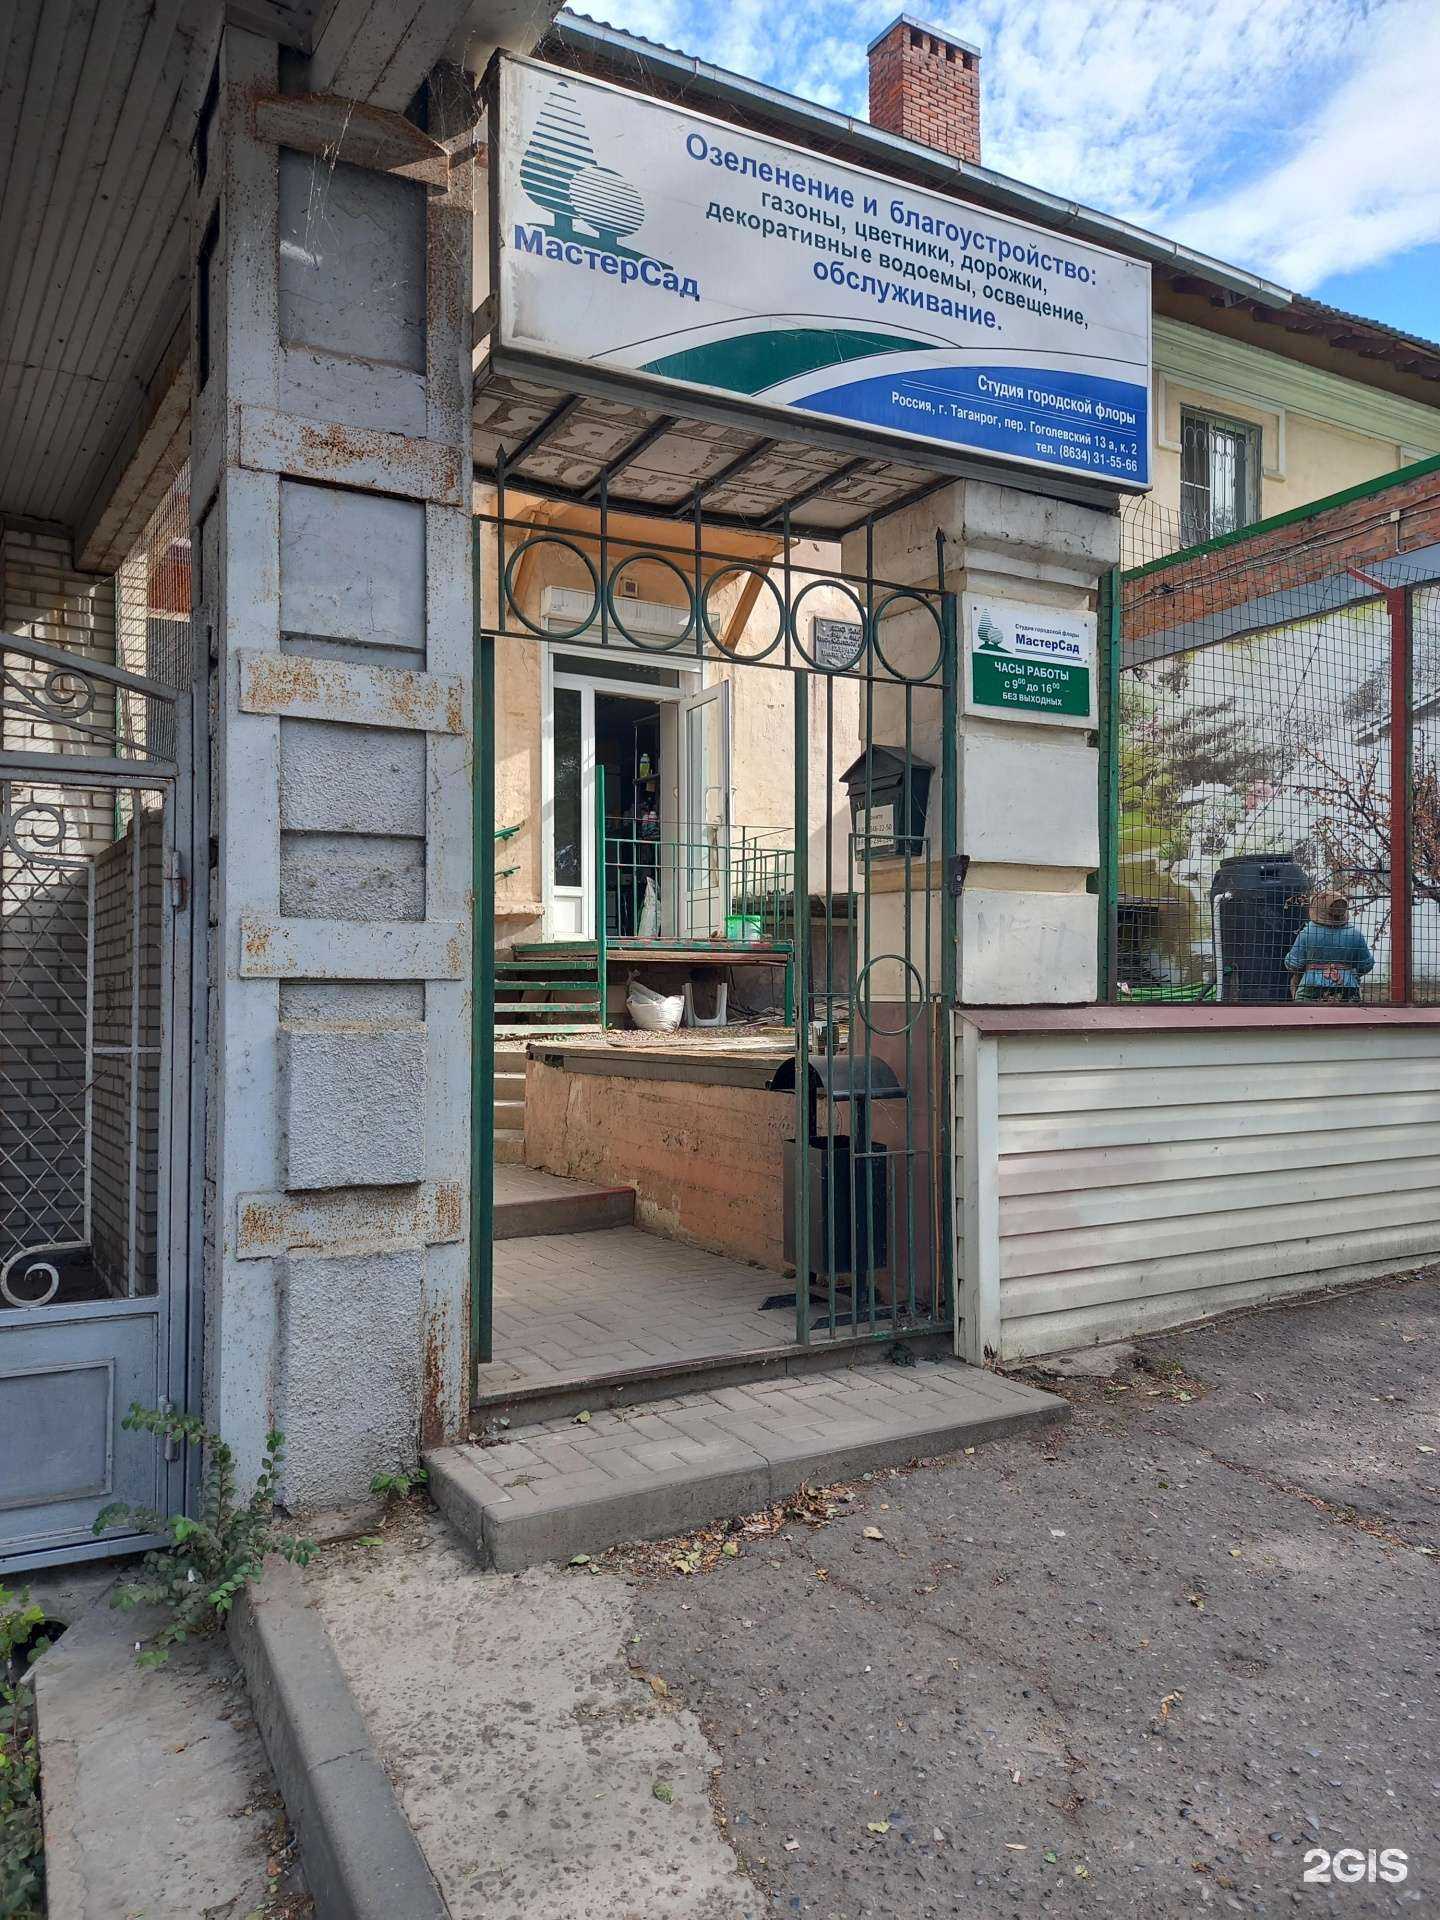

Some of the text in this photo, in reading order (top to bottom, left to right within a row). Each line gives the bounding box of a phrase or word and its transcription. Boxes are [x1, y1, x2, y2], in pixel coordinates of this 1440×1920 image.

[686, 133, 1097, 285] Озеленение и благоустройство:
[514, 224, 700, 302] МастерСад
[705, 202, 1089, 329] декоративные водоемы, освещение,
[762, 192, 1047, 295] газоны, цветники, дорожки,
[813, 261, 1002, 331] обслуживание.
[891, 391, 936, 415] Россия,
[938, 404, 948, 415] г.
[950, 403, 1002, 428] Таганрог,
[1004, 418, 1027, 433] пер.
[1030, 421, 1092, 445] Гоголевский
[1094, 435, 1106, 449] 13
[1120, 443, 1129, 453] к.
[1131, 443, 1138, 455] 2
[978, 374, 1136, 425] Студия городской флоры
[1035, 442, 1138, 472] тел. (8634) 31-55-66
[1015, 623, 1034, 632] Студия
[1035, 626, 1061, 636] городской
[1015, 633, 1080, 654] МастерСад
[994, 661, 1069, 681] ЧАСЫ РАБОТЫ
[1026, 684, 1038, 692] до
[1002, 692, 1063, 706] БЕЗ ВЫХОДНЫХ
